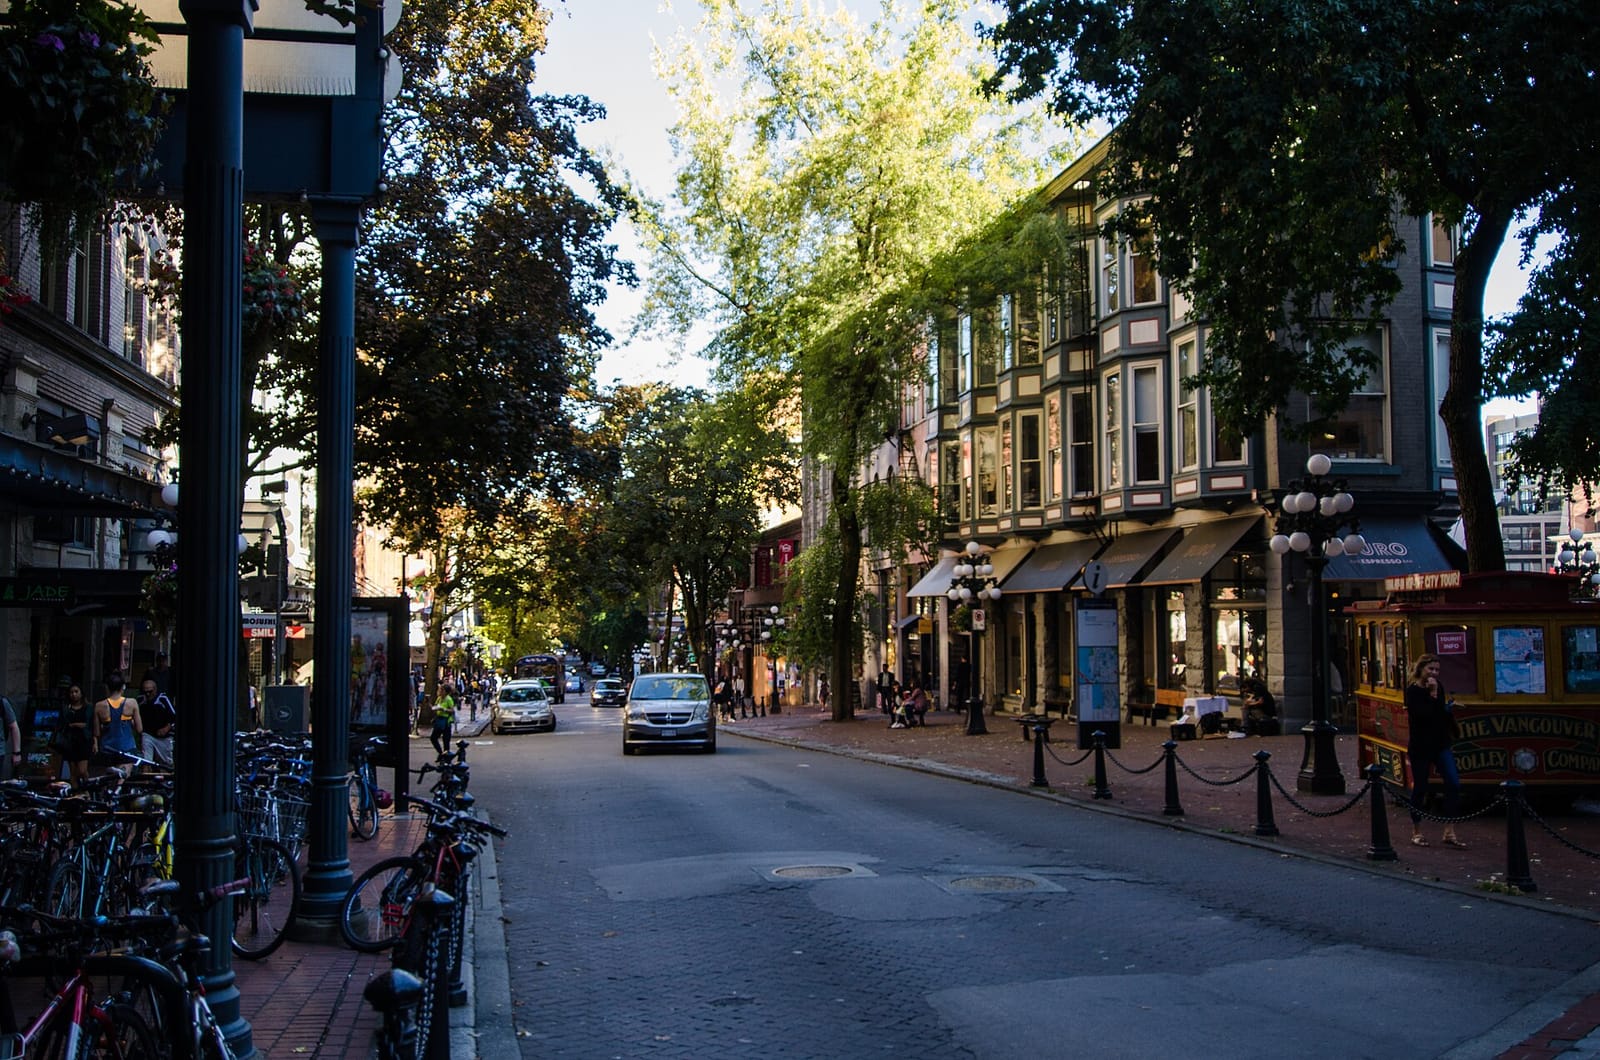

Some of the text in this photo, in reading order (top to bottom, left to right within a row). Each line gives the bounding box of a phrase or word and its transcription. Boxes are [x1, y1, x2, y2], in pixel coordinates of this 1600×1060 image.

[1343, 540, 1408, 556] URO
[1425, 575, 1439, 588] CITY
[17, 584, 71, 600] JADE
[1457, 716, 1595, 739] THE VANCOUVER
[1455, 751, 1507, 771] ROLLEY
